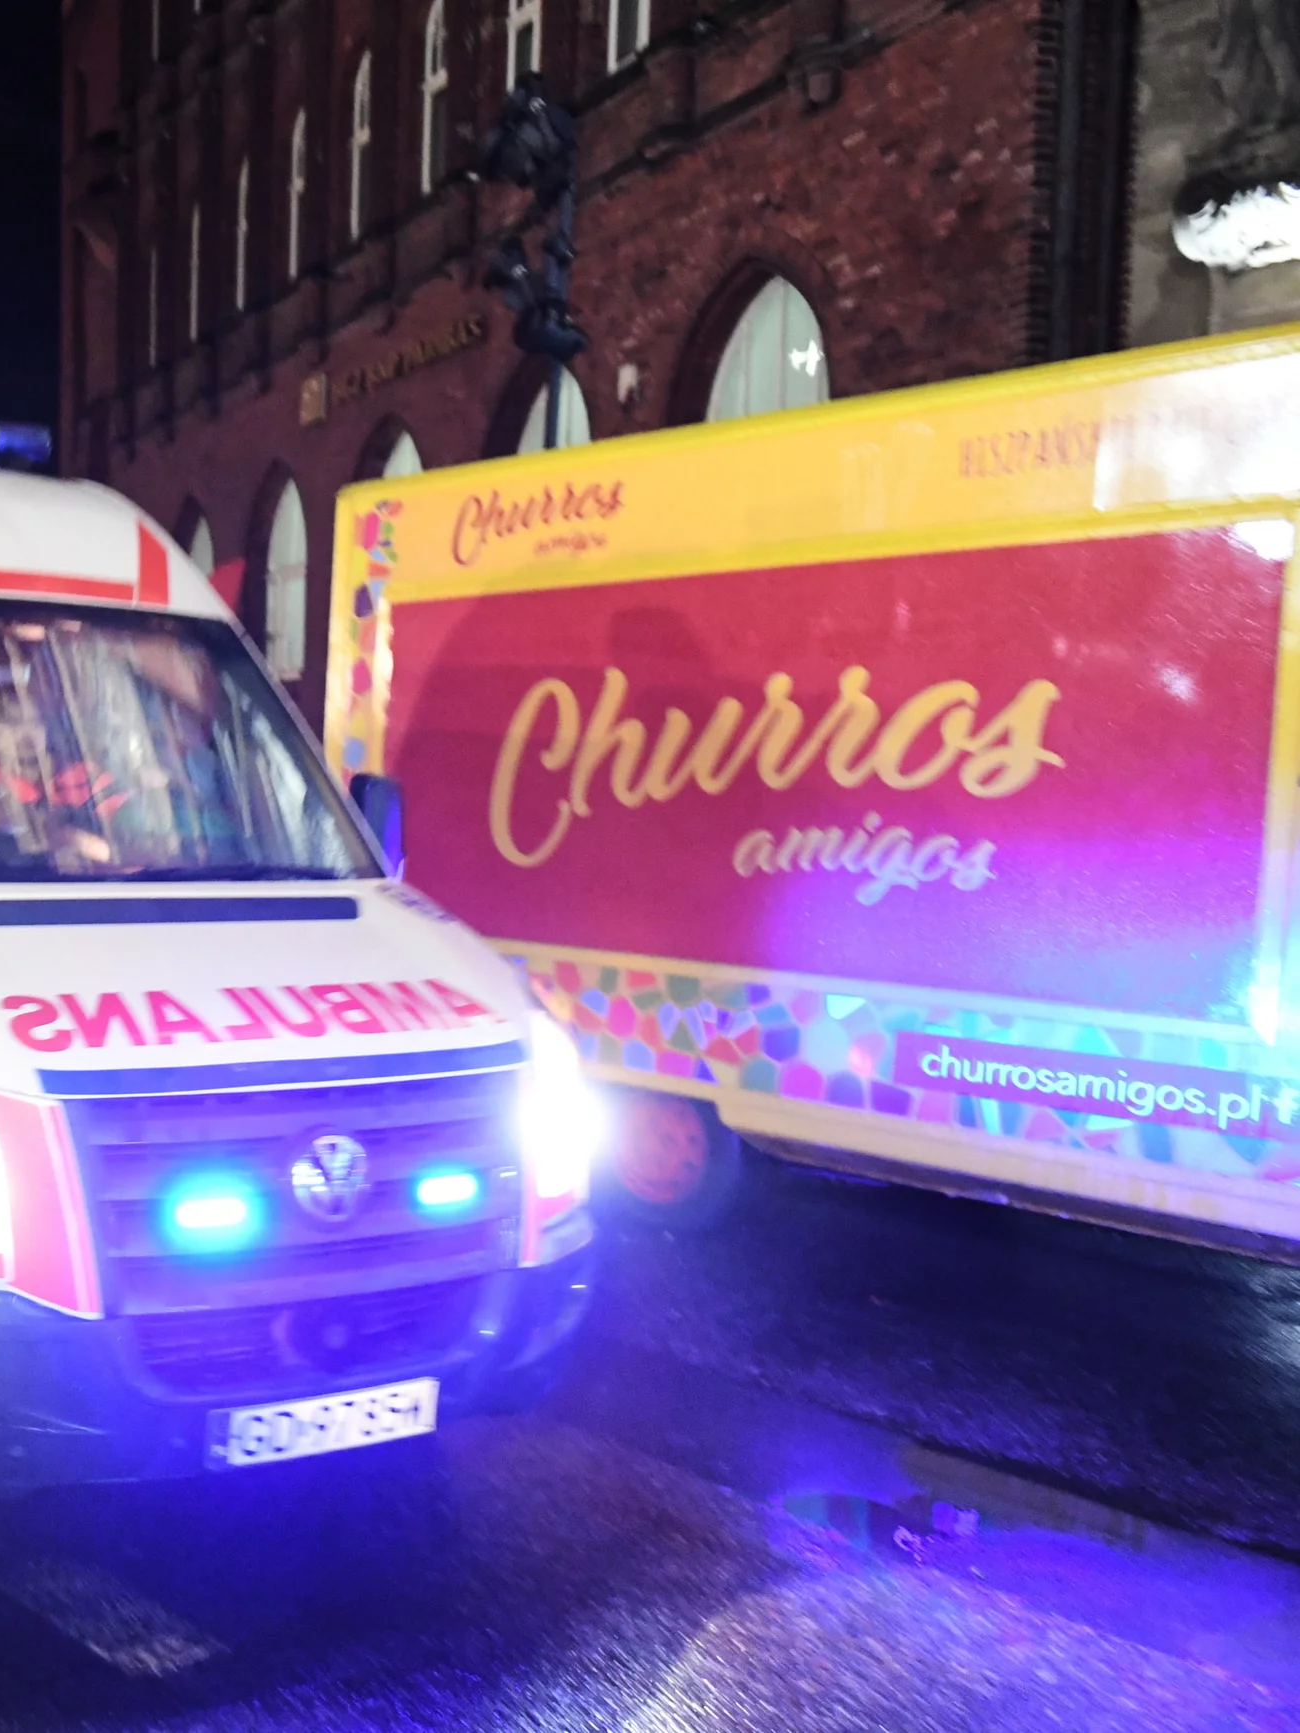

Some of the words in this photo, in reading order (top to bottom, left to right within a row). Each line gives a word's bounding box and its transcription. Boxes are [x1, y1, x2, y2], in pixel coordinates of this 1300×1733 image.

[452, 479, 626, 566] Churros
[488, 665, 1065, 868] Churros
[732, 811, 998, 906] amigos
[920, 1044, 1262, 1130] churrosamigos.pl
